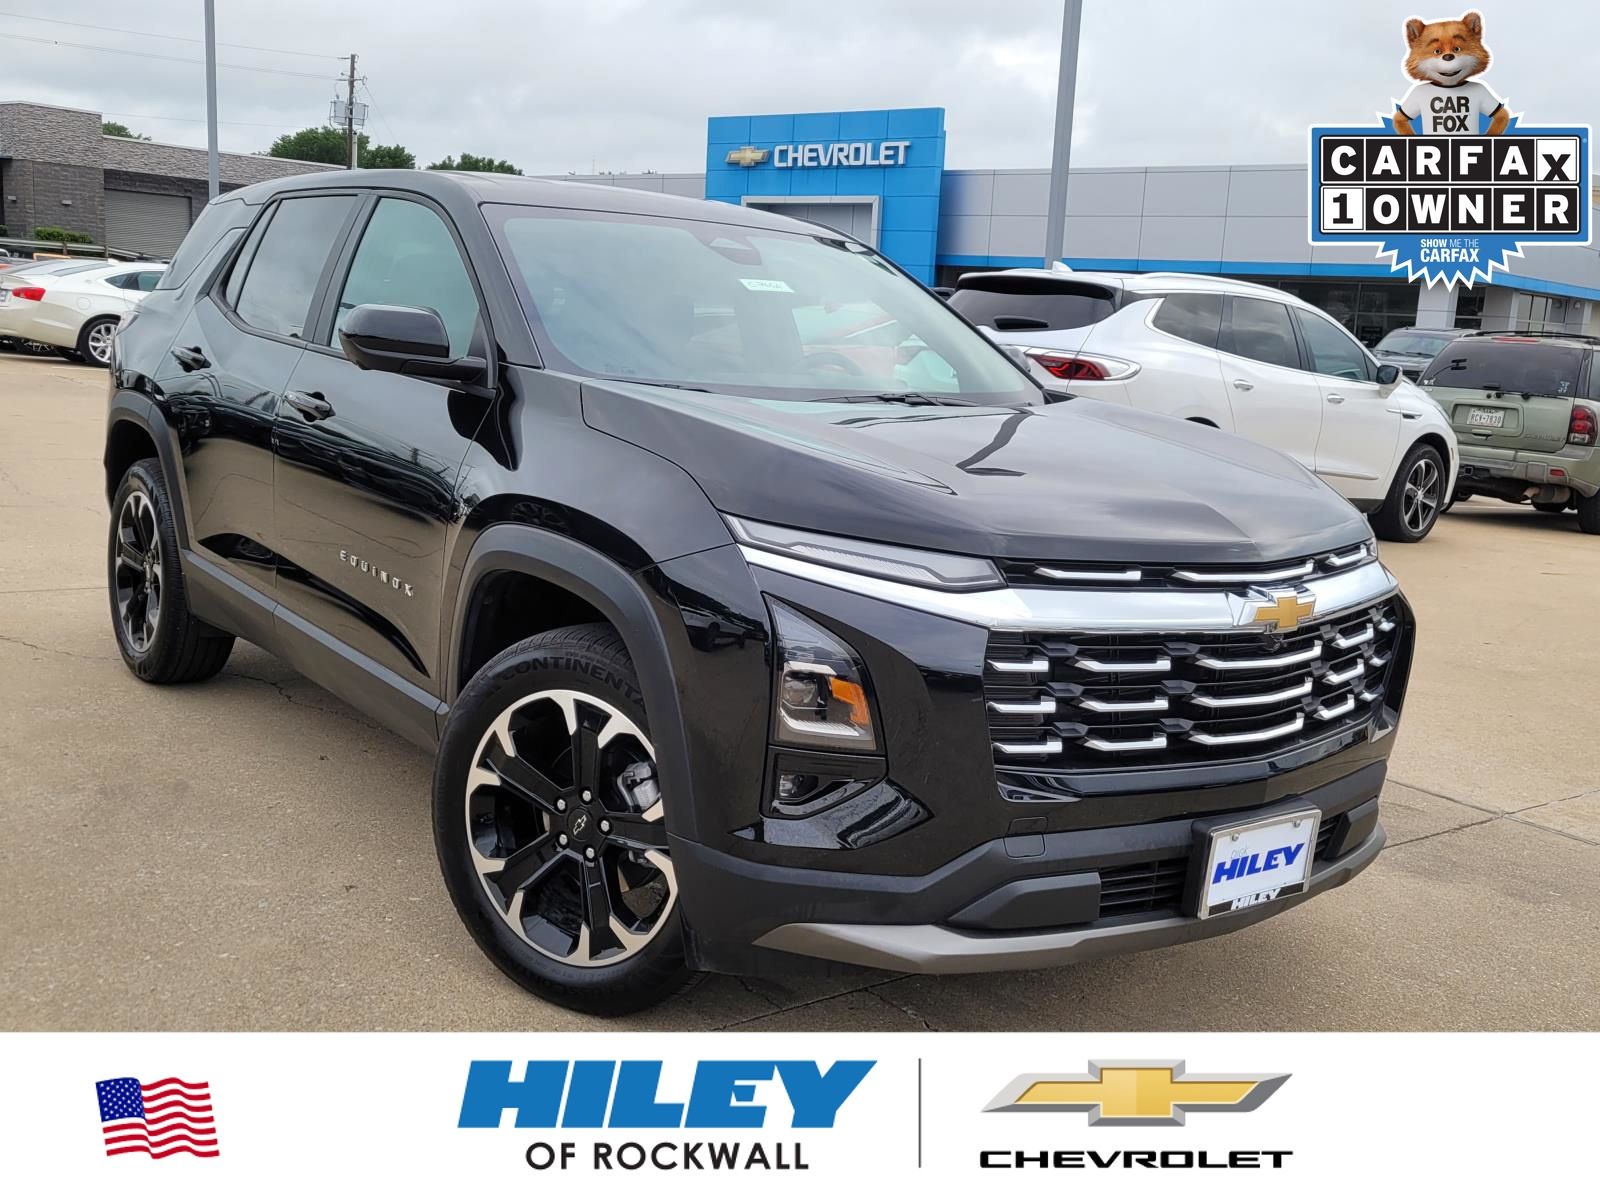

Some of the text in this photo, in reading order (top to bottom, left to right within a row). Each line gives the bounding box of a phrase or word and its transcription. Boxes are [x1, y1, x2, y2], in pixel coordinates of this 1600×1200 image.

[774, 141, 912, 168] CHEVROLET
[340, 549, 414, 597] EQUINOX
[1212, 842, 1305, 885] HILEY
[1231, 888, 1281, 911] HILEY
